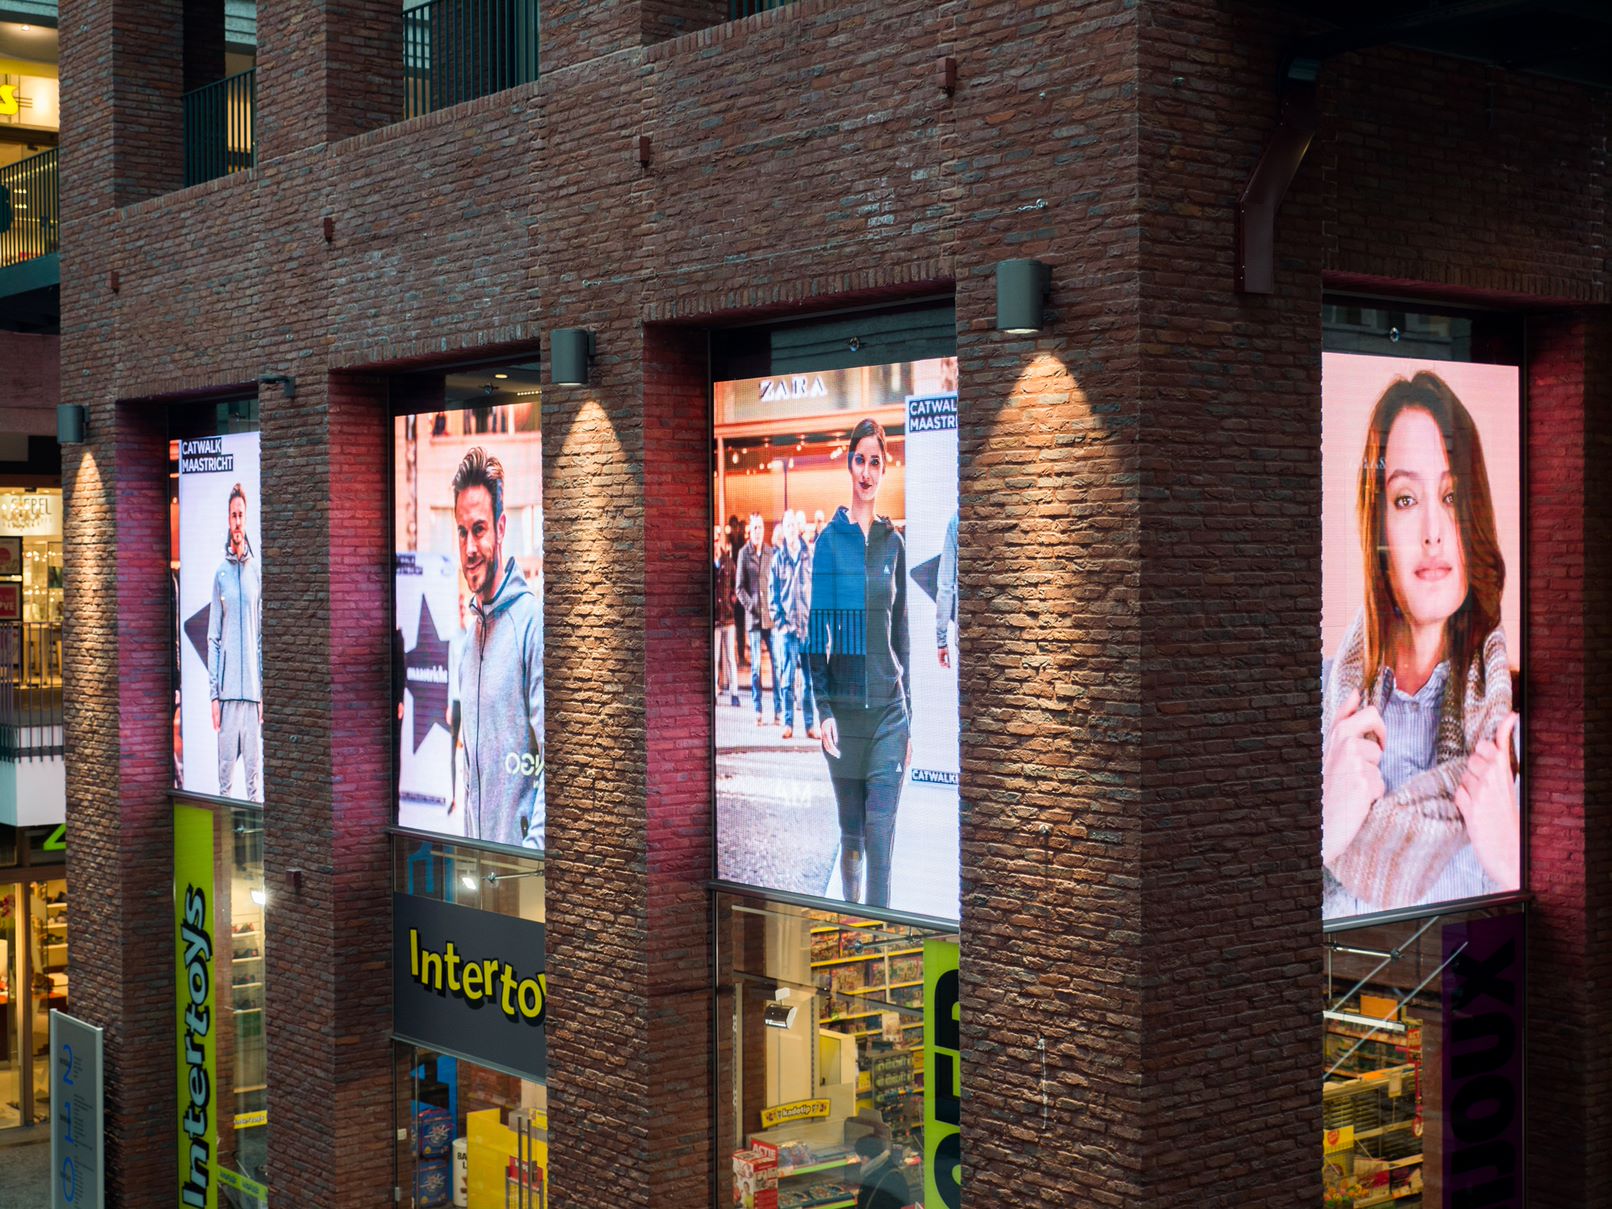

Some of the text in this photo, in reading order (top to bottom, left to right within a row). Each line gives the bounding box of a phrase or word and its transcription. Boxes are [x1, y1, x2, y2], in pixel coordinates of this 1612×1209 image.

[758, 375, 827, 402] ZARA
[182, 439, 221, 455] CATWALK
[182, 456, 233, 473] MAASTRICHT
[182, 885, 212, 1209] Intertoys
[752, 1144, 776, 1160] ACTIE
